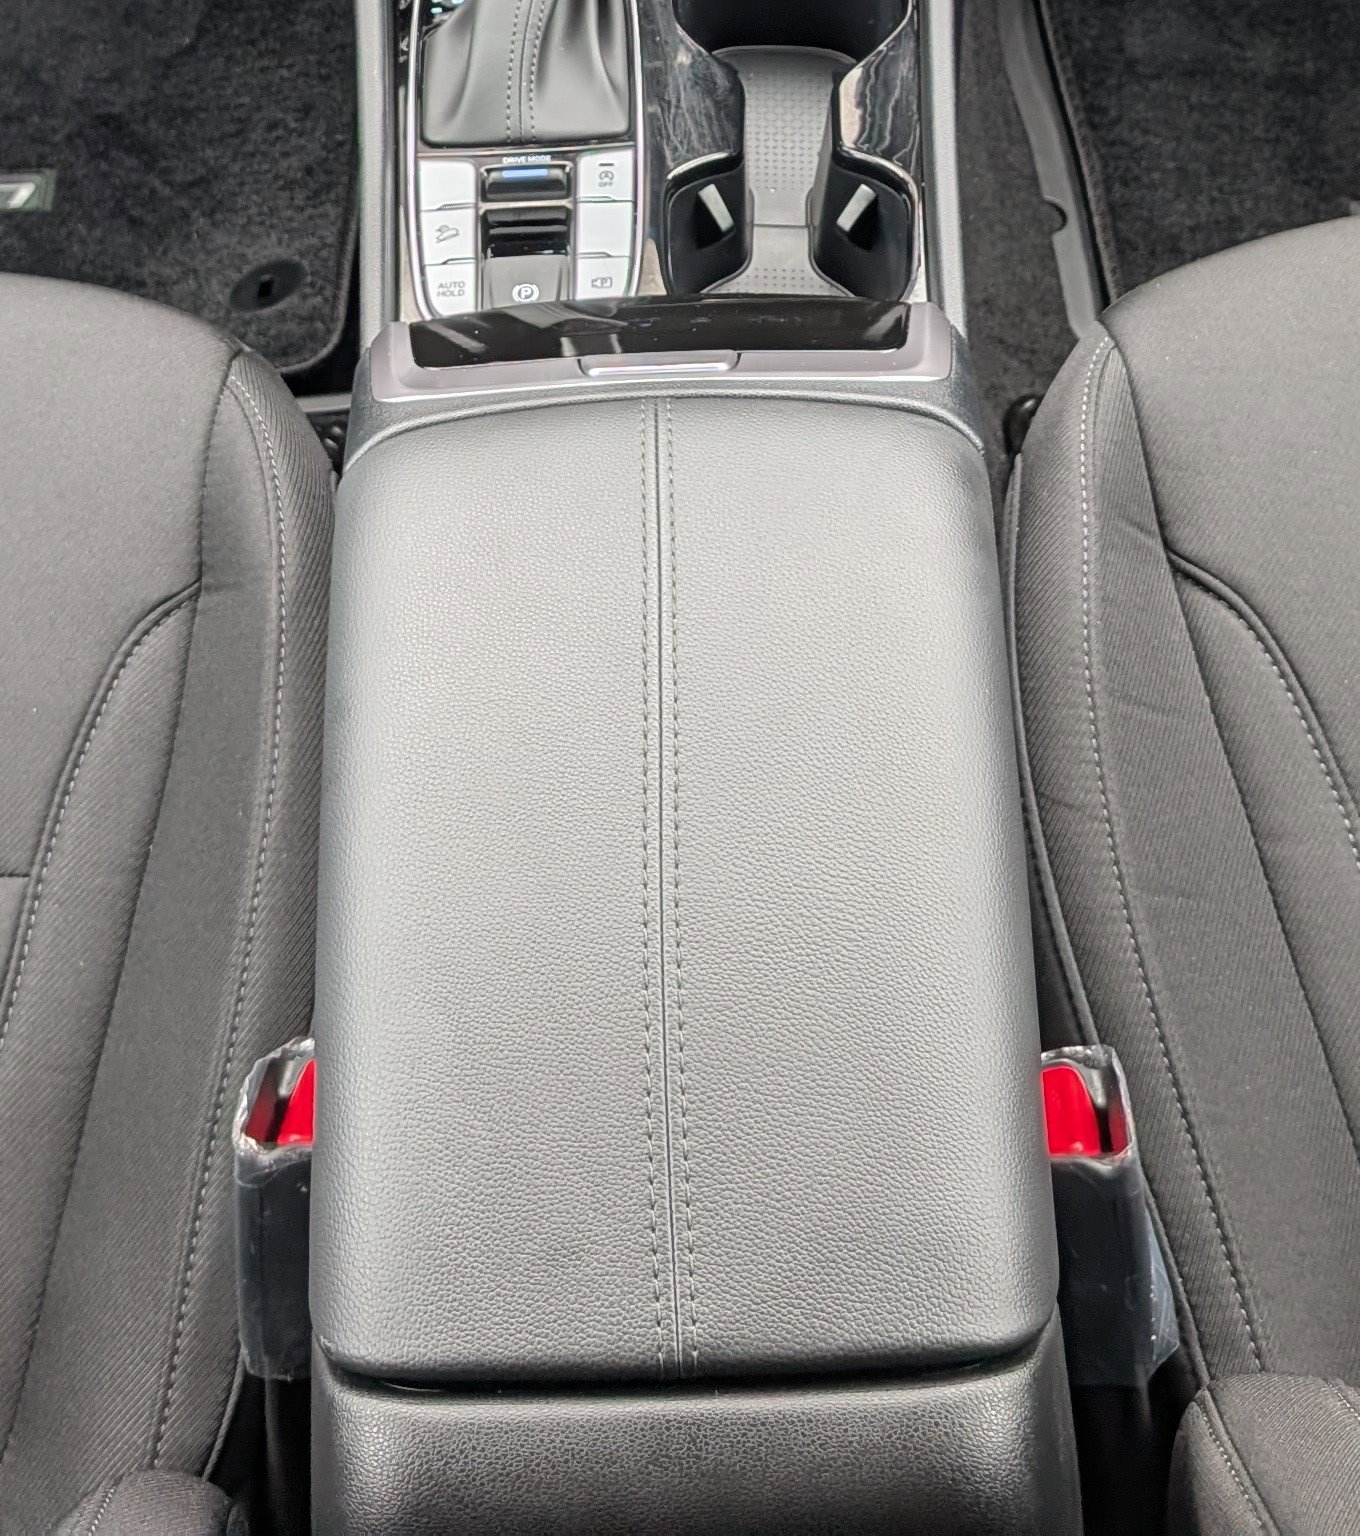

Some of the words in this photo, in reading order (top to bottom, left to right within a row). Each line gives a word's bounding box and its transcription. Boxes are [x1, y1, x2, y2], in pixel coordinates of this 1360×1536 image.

[502, 156, 526, 164] DRIVE
[527, 154, 552, 163] MODE
[437, 281, 466, 290] AUTO
[437, 289, 465, 298] HOLD
